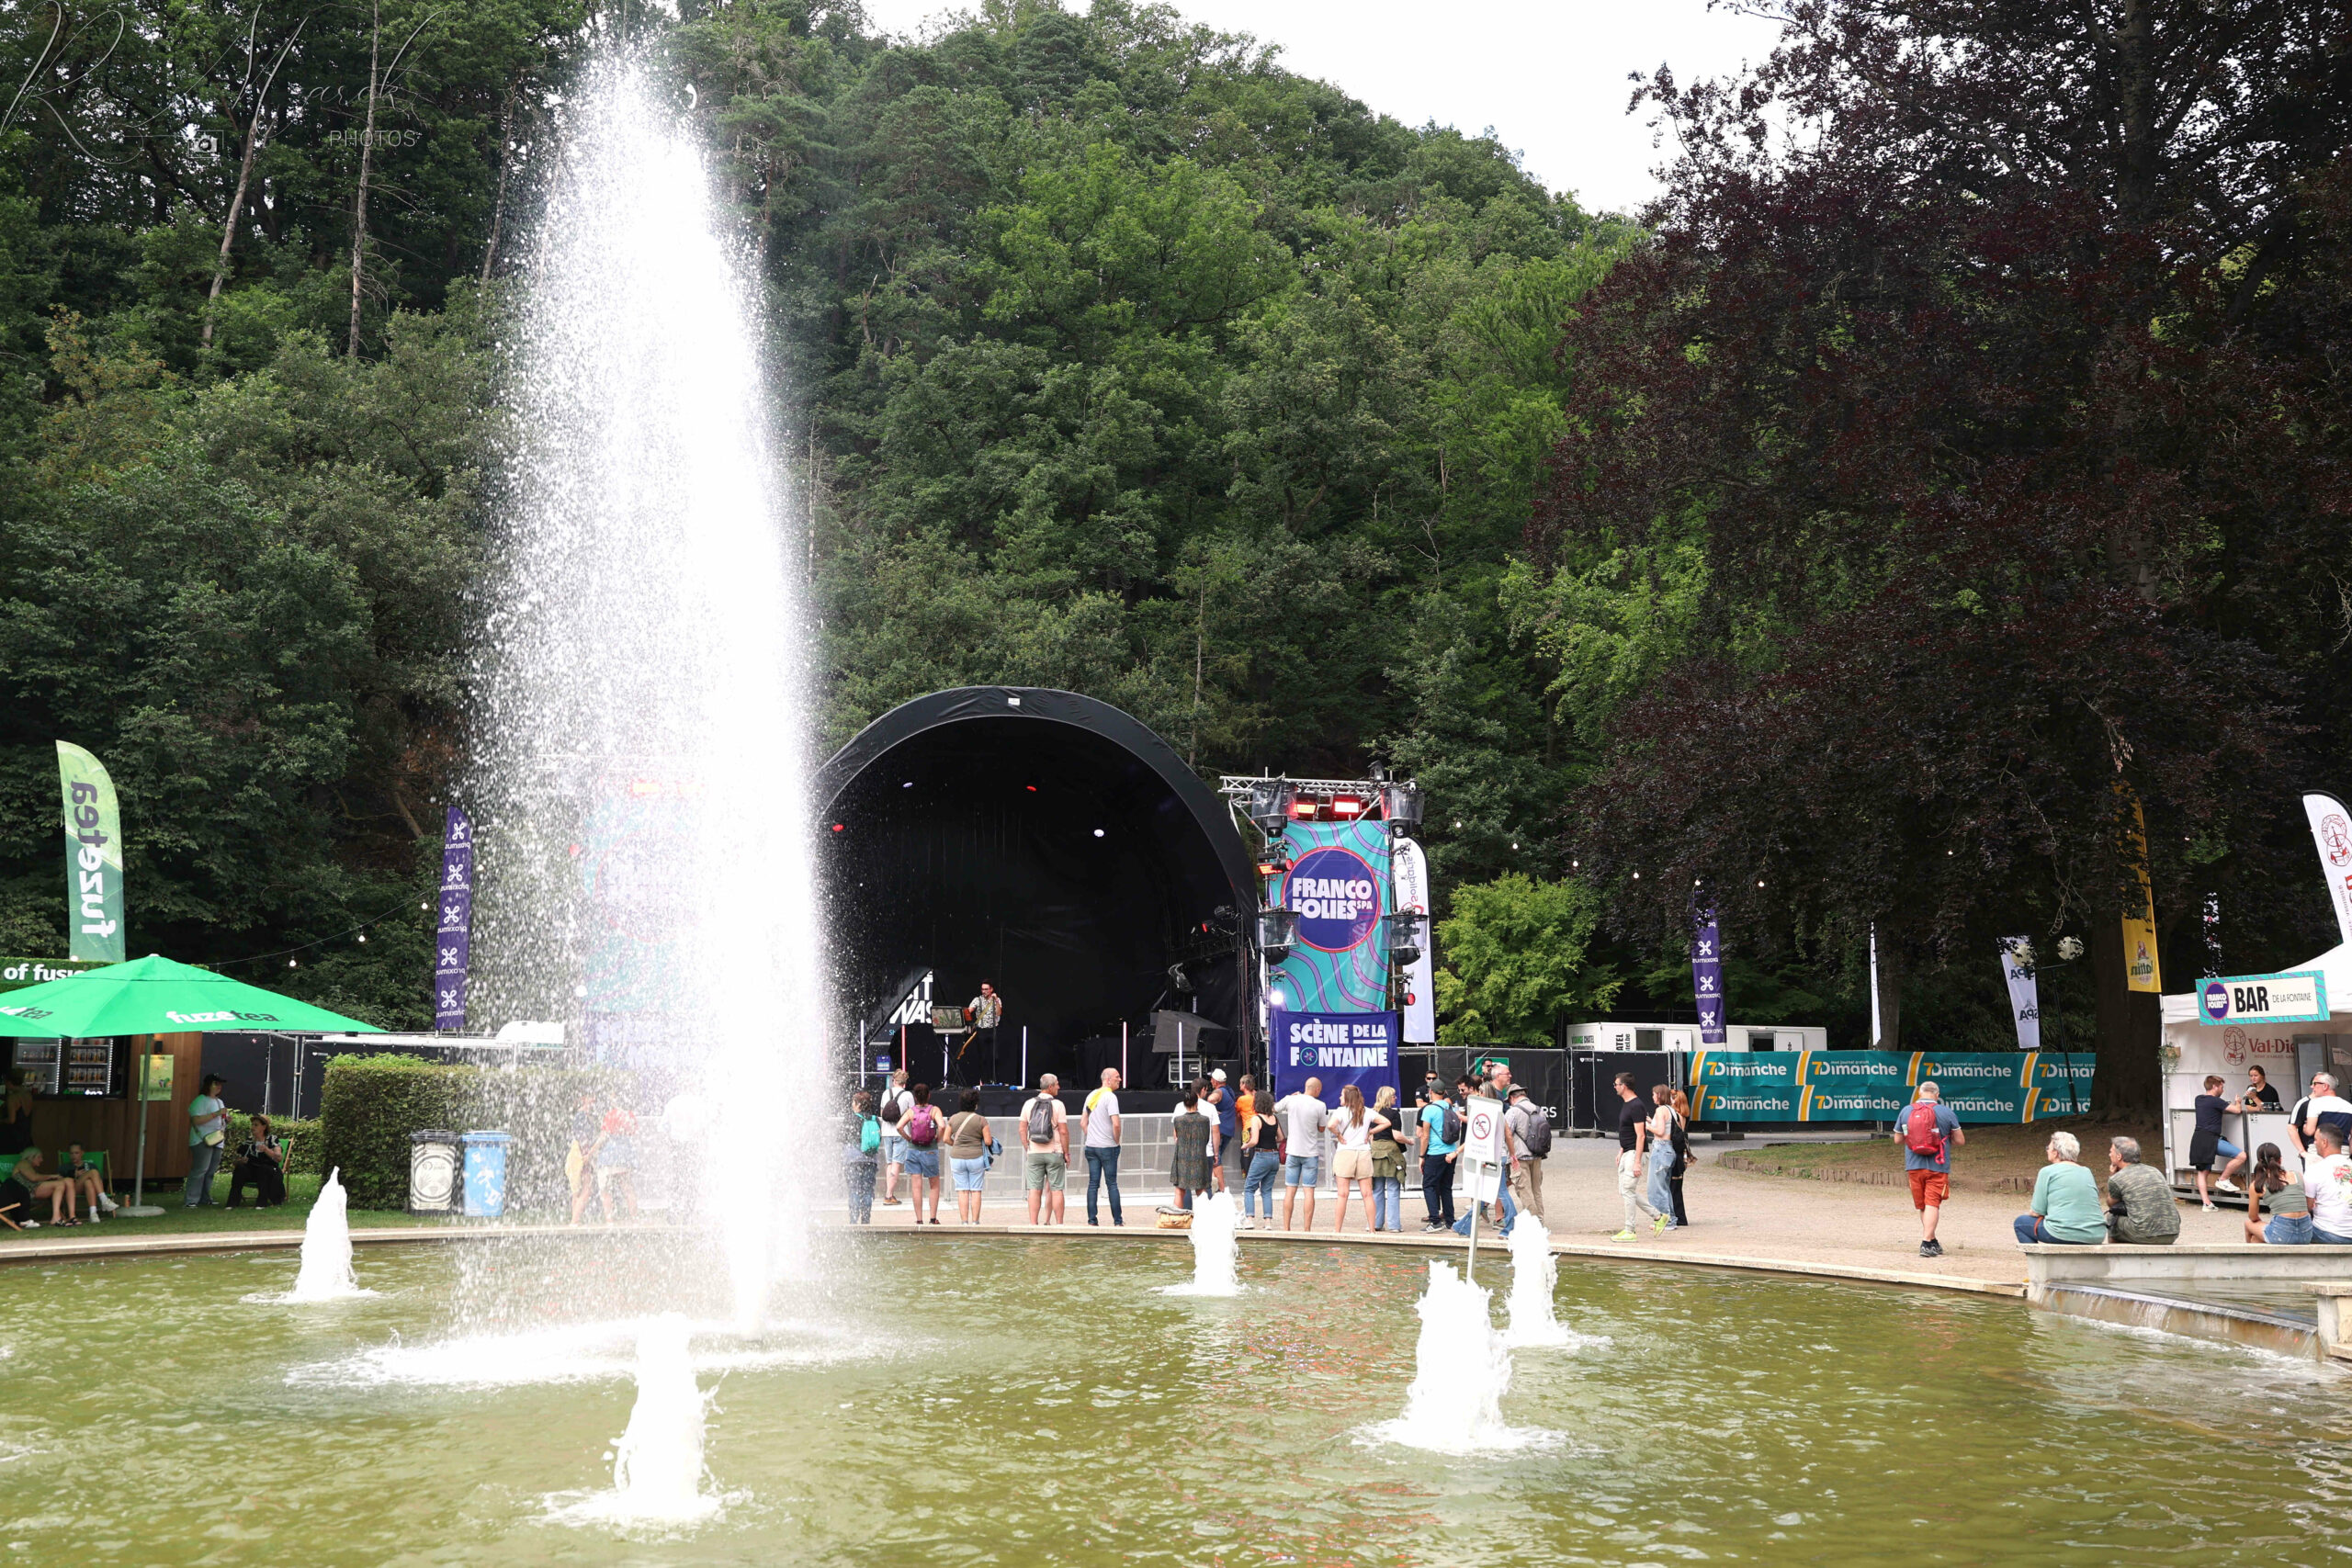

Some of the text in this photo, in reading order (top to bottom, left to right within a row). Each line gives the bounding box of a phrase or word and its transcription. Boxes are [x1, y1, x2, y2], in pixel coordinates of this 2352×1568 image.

[1293, 877, 1373, 900] FRANCO
[1293, 898, 1373, 920] FOLIES SPA
[4, 963, 29, 980] of
[2233, 987, 2269, 1012] BAR
[2272, 995, 2280, 1003] DE
[2287, 992, 2312, 1002] FONTAINE
[166, 1010, 279, 1023] fuzetea
[1290, 1019, 1386, 1044] SCÈNE DE LA
[2248, 1037, 2295, 1054] Val-Die
[1290, 1046, 1388, 1067] FONTAINE
[1706, 1061, 1787, 1077] 7Dimanche
[1812, 1061, 1897, 1076] 7Dimanche
[1923, 1062, 2012, 1077] 7Dimanche
[1707, 1095, 1790, 1111] 7Dimanche
[1815, 1095, 1901, 1110] 7Dimanche
[1544, 1106, 1557, 1118] RS
